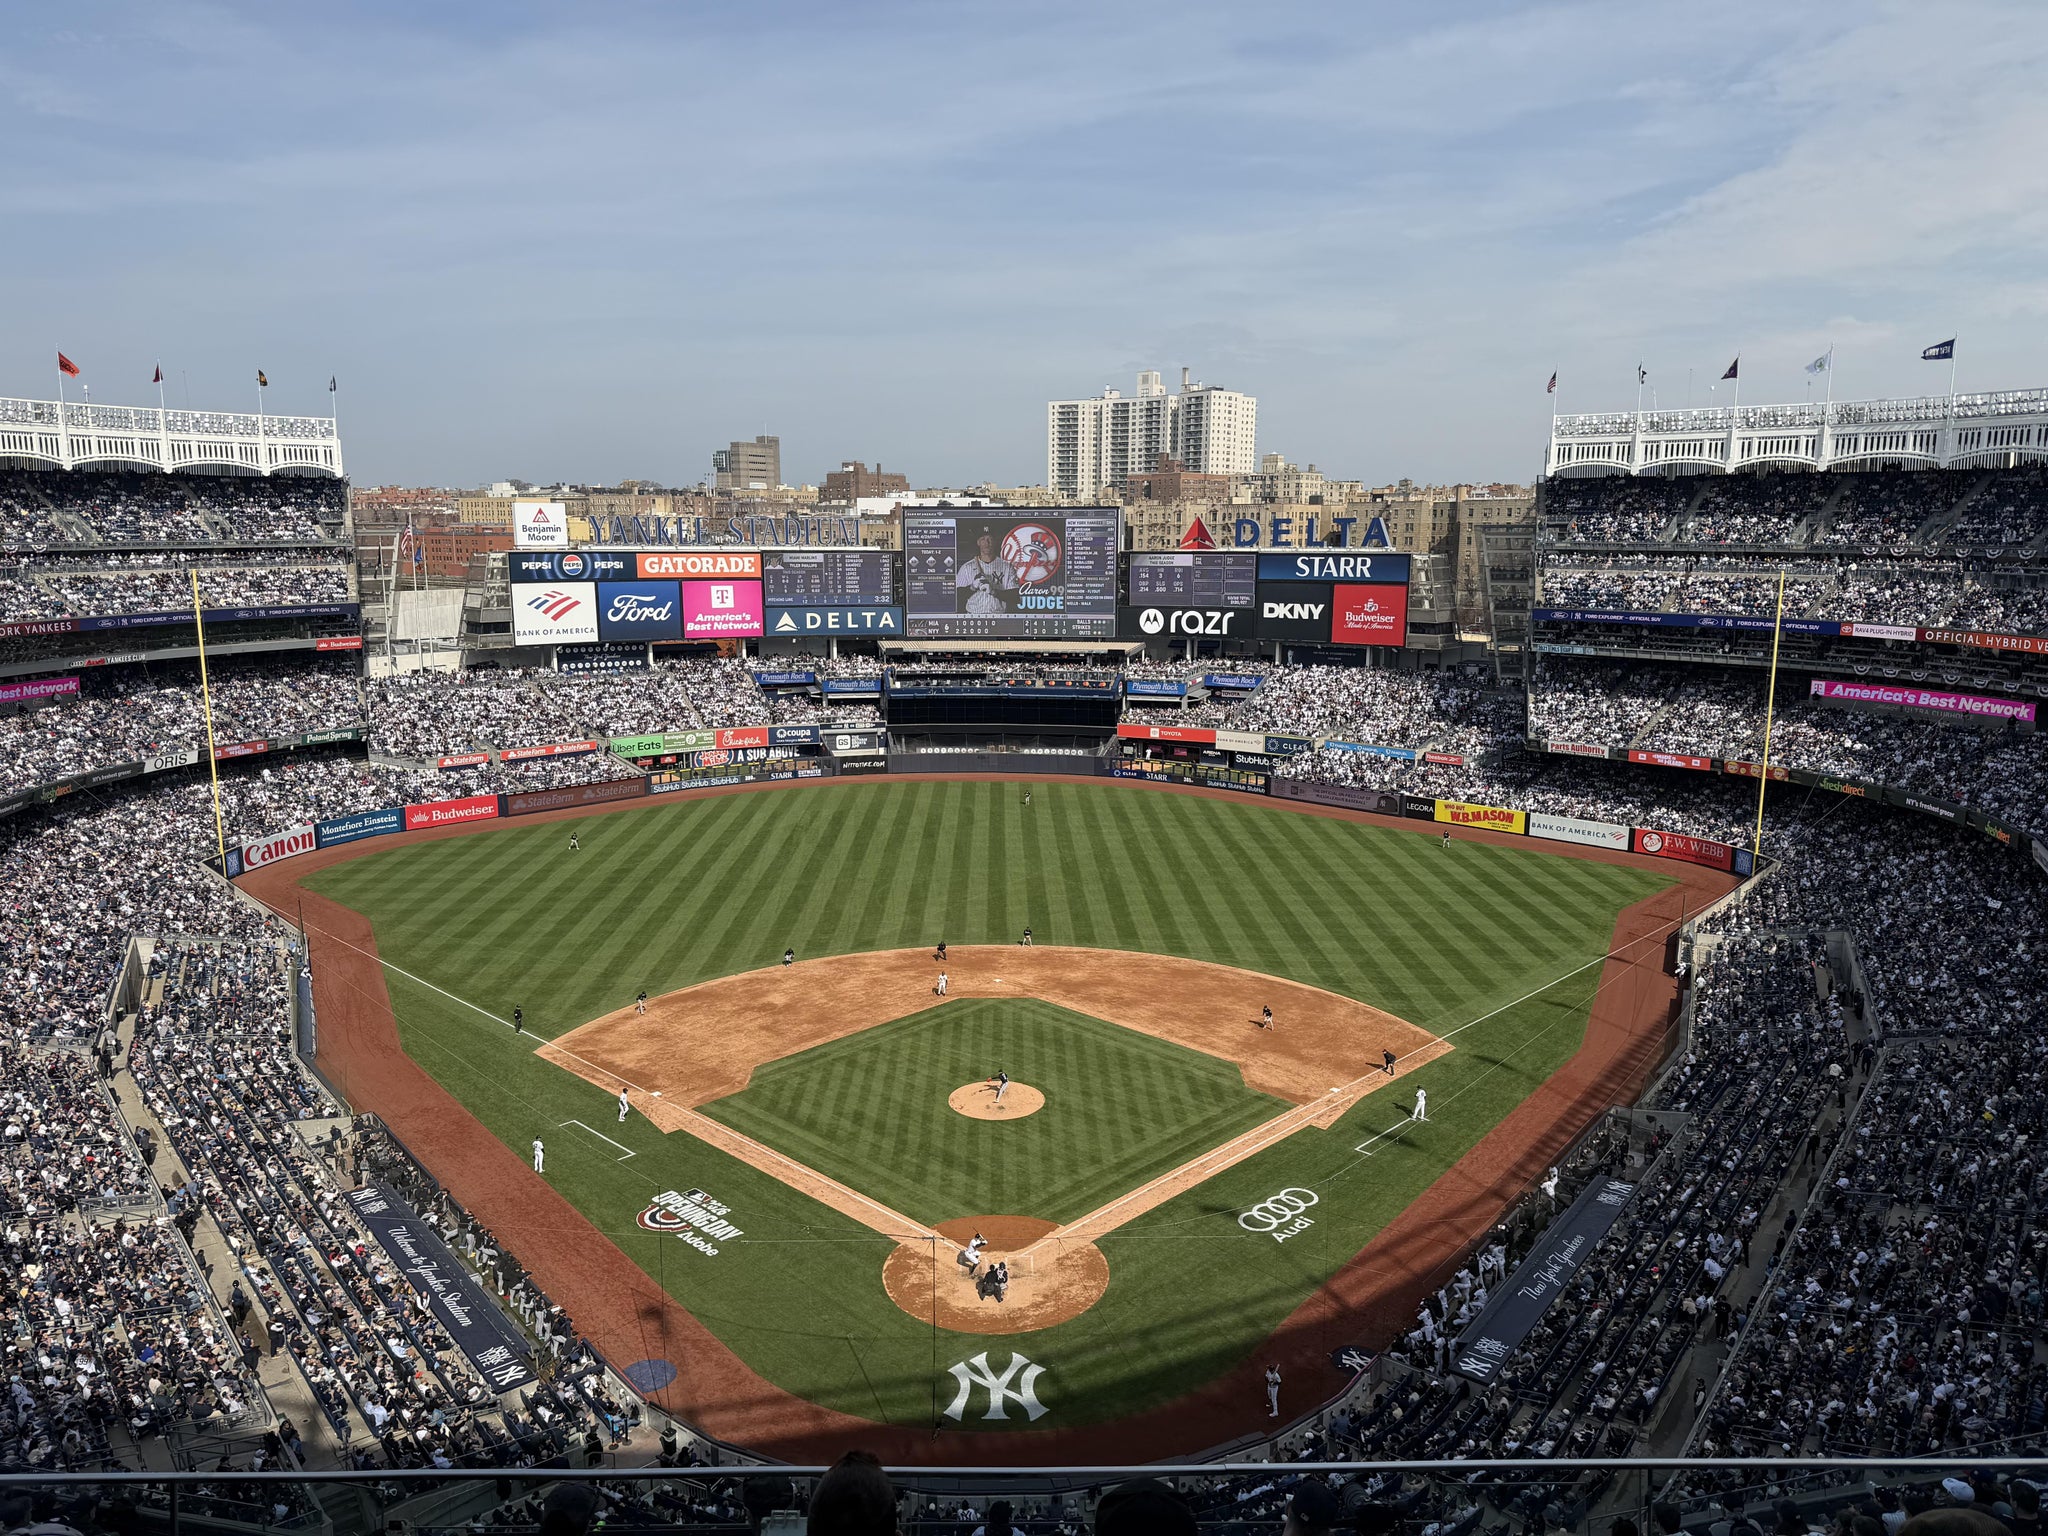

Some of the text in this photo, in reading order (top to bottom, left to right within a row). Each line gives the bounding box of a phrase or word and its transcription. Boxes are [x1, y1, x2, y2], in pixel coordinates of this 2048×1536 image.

[522, 524, 561, 535] Benjamin
[588, 515, 861, 546] YANKEE STADIUM
[1235, 517, 1394, 548] DELTA
[522, 561, 551, 570] PEPSI
[594, 561, 623, 569] PEPSI
[644, 556, 755, 574] GATORADE
[1295, 556, 1372, 578] STARR
[1019, 581, 1065, 596] Aaron 99
[607, 594, 673, 623] Ford
[1017, 595, 1065, 610] JUDGE
[695, 612, 751, 622] America's
[1263, 602, 1325, 620] DKNY
[1345, 611, 1396, 623] Budweiser
[24, 621, 72, 634] YANKEES
[686, 620, 761, 631] Best Network
[806, 612, 895, 629] DELTA
[1170, 610, 1235, 635] razr
[516, 627, 595, 637] BANK OF AMERICA
[1869, 628, 1893, 636] PLUG-IN
[1893, 629, 1914, 637] HYBRID
[1925, 630, 2032, 650] OFFICIAL HYBRID
[106, 655, 132, 664] YANKEES
[132, 654, 146, 662] CLUB
[761, 672, 806, 681] Plymouth Rock
[858, 680, 875, 688] Rock
[1212, 675, 1257, 685] Plymouth Rock
[22, 680, 77, 697] Network
[1132, 682, 1179, 691] Plymouth Rock
[1831, 685, 1918, 704] America's
[1918, 693, 1957, 710] Best
[1958, 697, 2030, 719] Network
[307, 731, 353, 744] Poland Spring
[787, 728, 811, 737] coupa
[612, 744, 635, 753] Uber
[637, 742, 661, 751] Eats
[737, 746, 800, 762] A SUB ABOVE
[1550, 742, 1606, 755] Parts Authority
[153, 753, 188, 770] ORIS
[1235, 754, 1270, 766] StubHub
[1146, 773, 1168, 781] STARR
[653, 777, 739, 793] StubHub StubHub StubHub
[321, 814, 397, 836] Montefiore Einstein
[1531, 822, 1607, 840] BANK OF AMERICA
[243, 831, 314, 867] Canon
[1664, 836, 1686, 850] F.W.
[1690, 839, 1724, 858] WEBB
[1271, 1215, 1315, 1244] Audi
[676, 1231, 719, 1257] Adobe
[1517, 1234, 1586, 1300] New York Yankees
[387, 1225, 473, 1327] Welcome to Yankee Stadium
